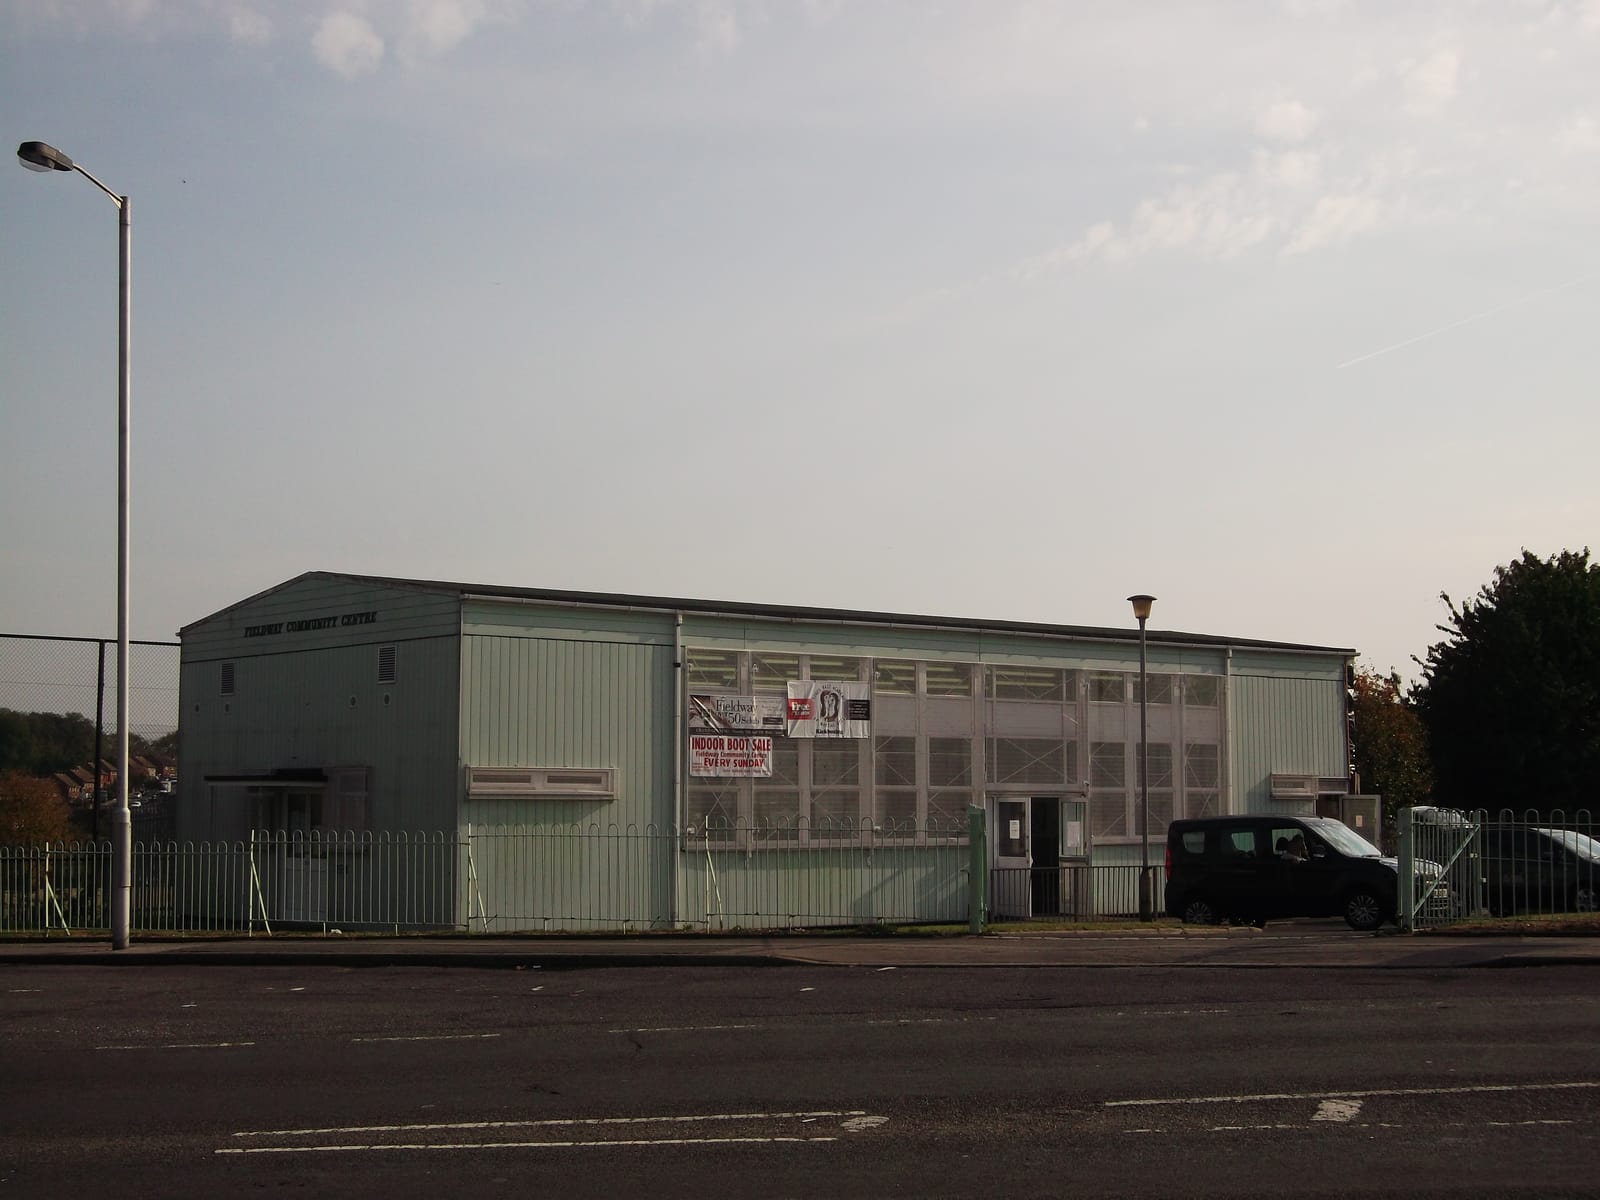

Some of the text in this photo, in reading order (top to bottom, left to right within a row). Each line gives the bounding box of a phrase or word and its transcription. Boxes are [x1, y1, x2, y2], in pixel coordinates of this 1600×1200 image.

[244, 611, 378, 638] FIELDWAY COMMUNITY CENTRE
[716, 699, 758, 714] Fieldway
[791, 701, 810, 711] Free
[691, 737, 771, 752] INDOOR BOOT SALE
[695, 750, 720, 758] Fieldway
[720, 751, 750, 759] Community
[703, 758, 765, 768] EVERY SUNDAY
